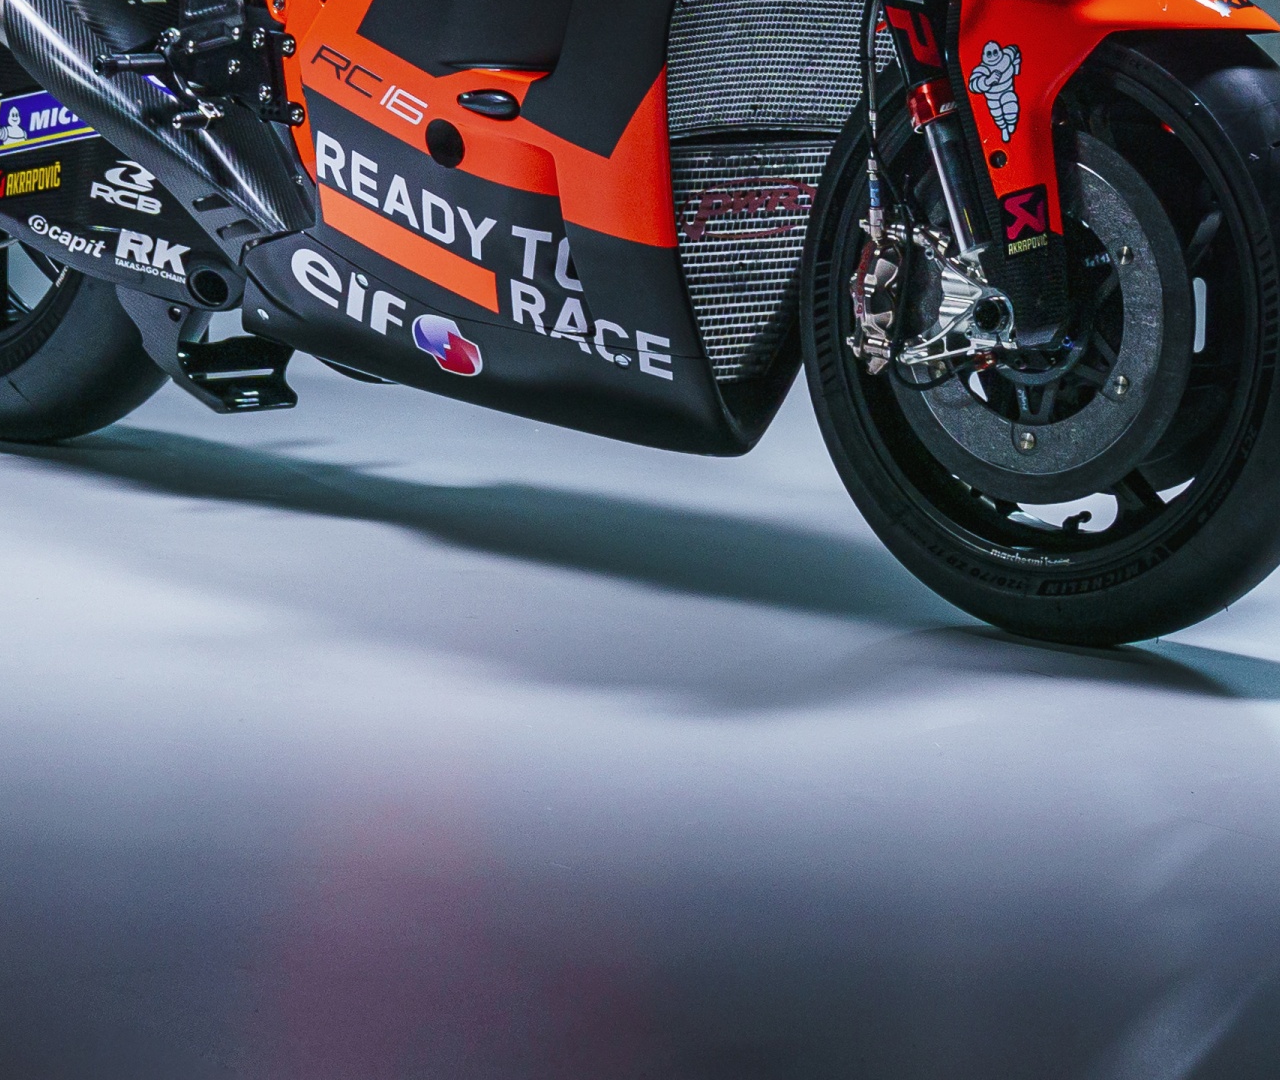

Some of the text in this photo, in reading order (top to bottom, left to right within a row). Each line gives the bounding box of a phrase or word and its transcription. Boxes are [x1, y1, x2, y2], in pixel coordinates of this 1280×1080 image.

[90, 181, 162, 215] RCB
[315, 130, 498, 261] READY
[114, 257, 187, 285] TAKASAGO CHAIN
[115, 228, 191, 275] RK
[510, 279, 674, 381] RACE
